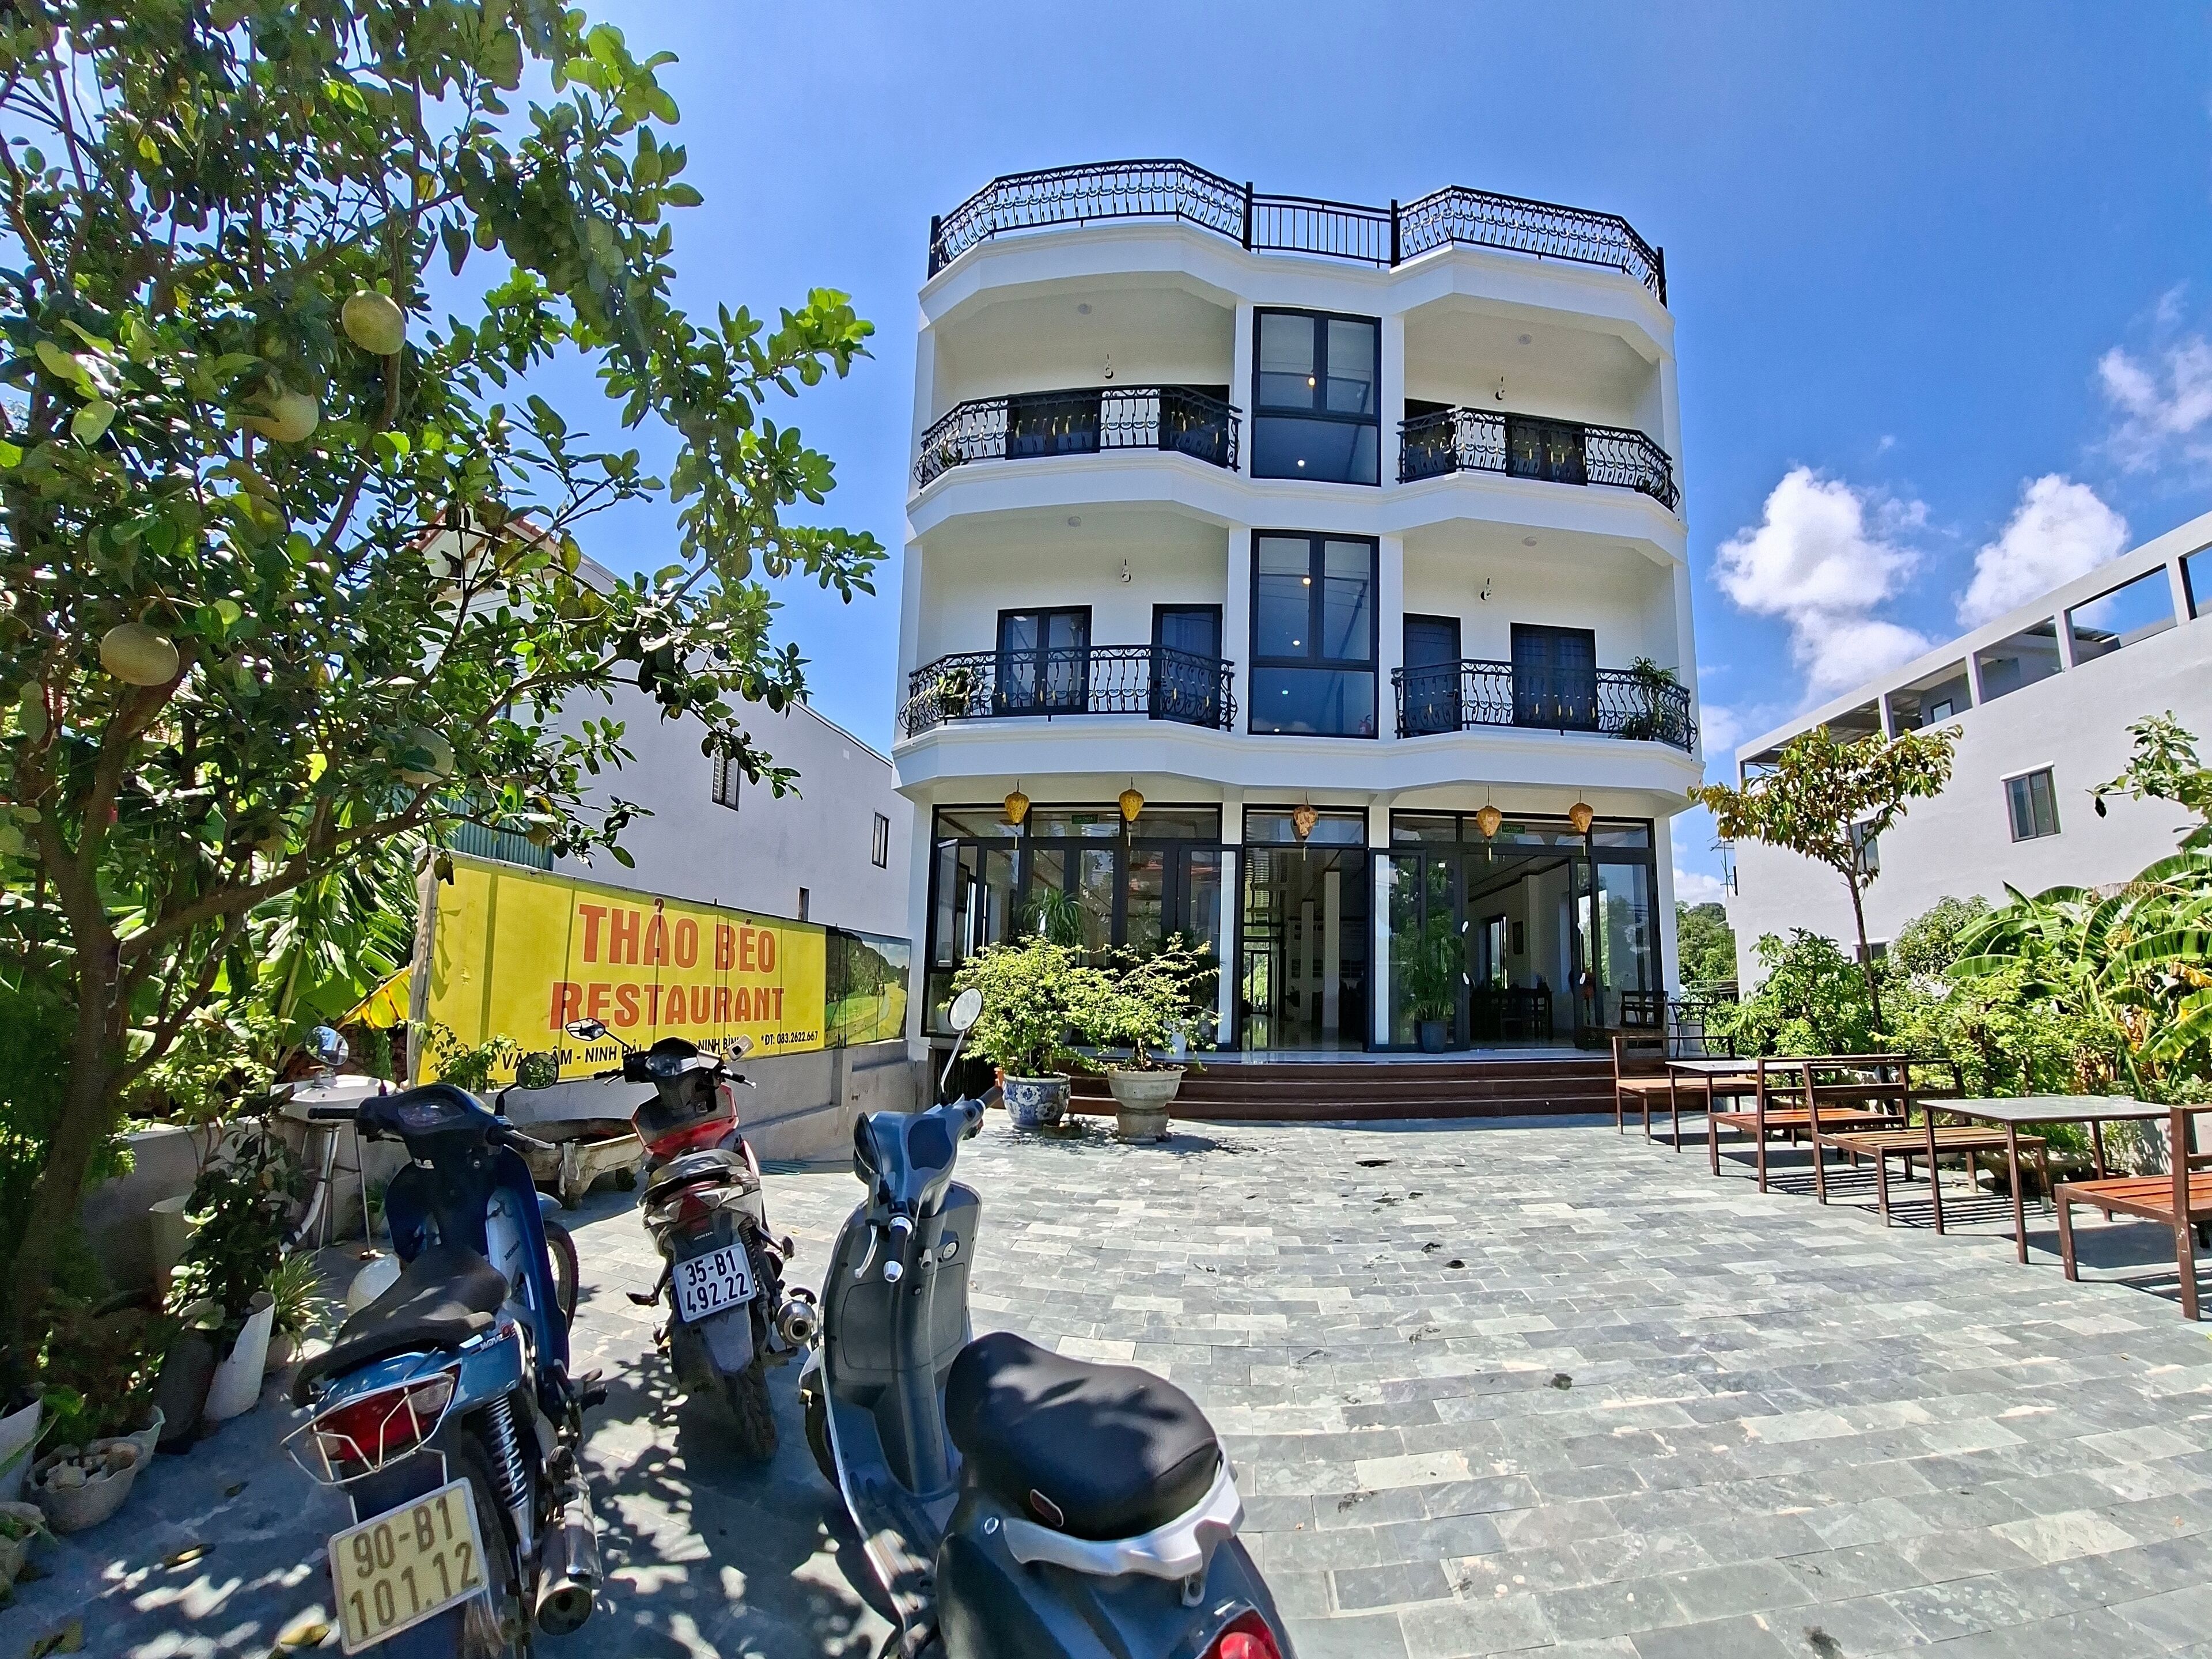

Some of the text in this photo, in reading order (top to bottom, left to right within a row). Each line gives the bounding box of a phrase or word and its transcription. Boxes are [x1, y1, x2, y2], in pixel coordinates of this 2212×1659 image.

[579, 897, 776, 974] THẢO BÉO
[550, 982, 785, 1030] RESTAURANT
[585, 1046, 617, 1063] NINH
[777, 1031, 818, 1044] 083.2622.667
[685, 1249, 736, 1286] 35-B1
[687, 1272, 749, 1313] 492.22
[353, 1497, 453, 1578] 90-B1
[349, 1541, 478, 1636] 101.12
